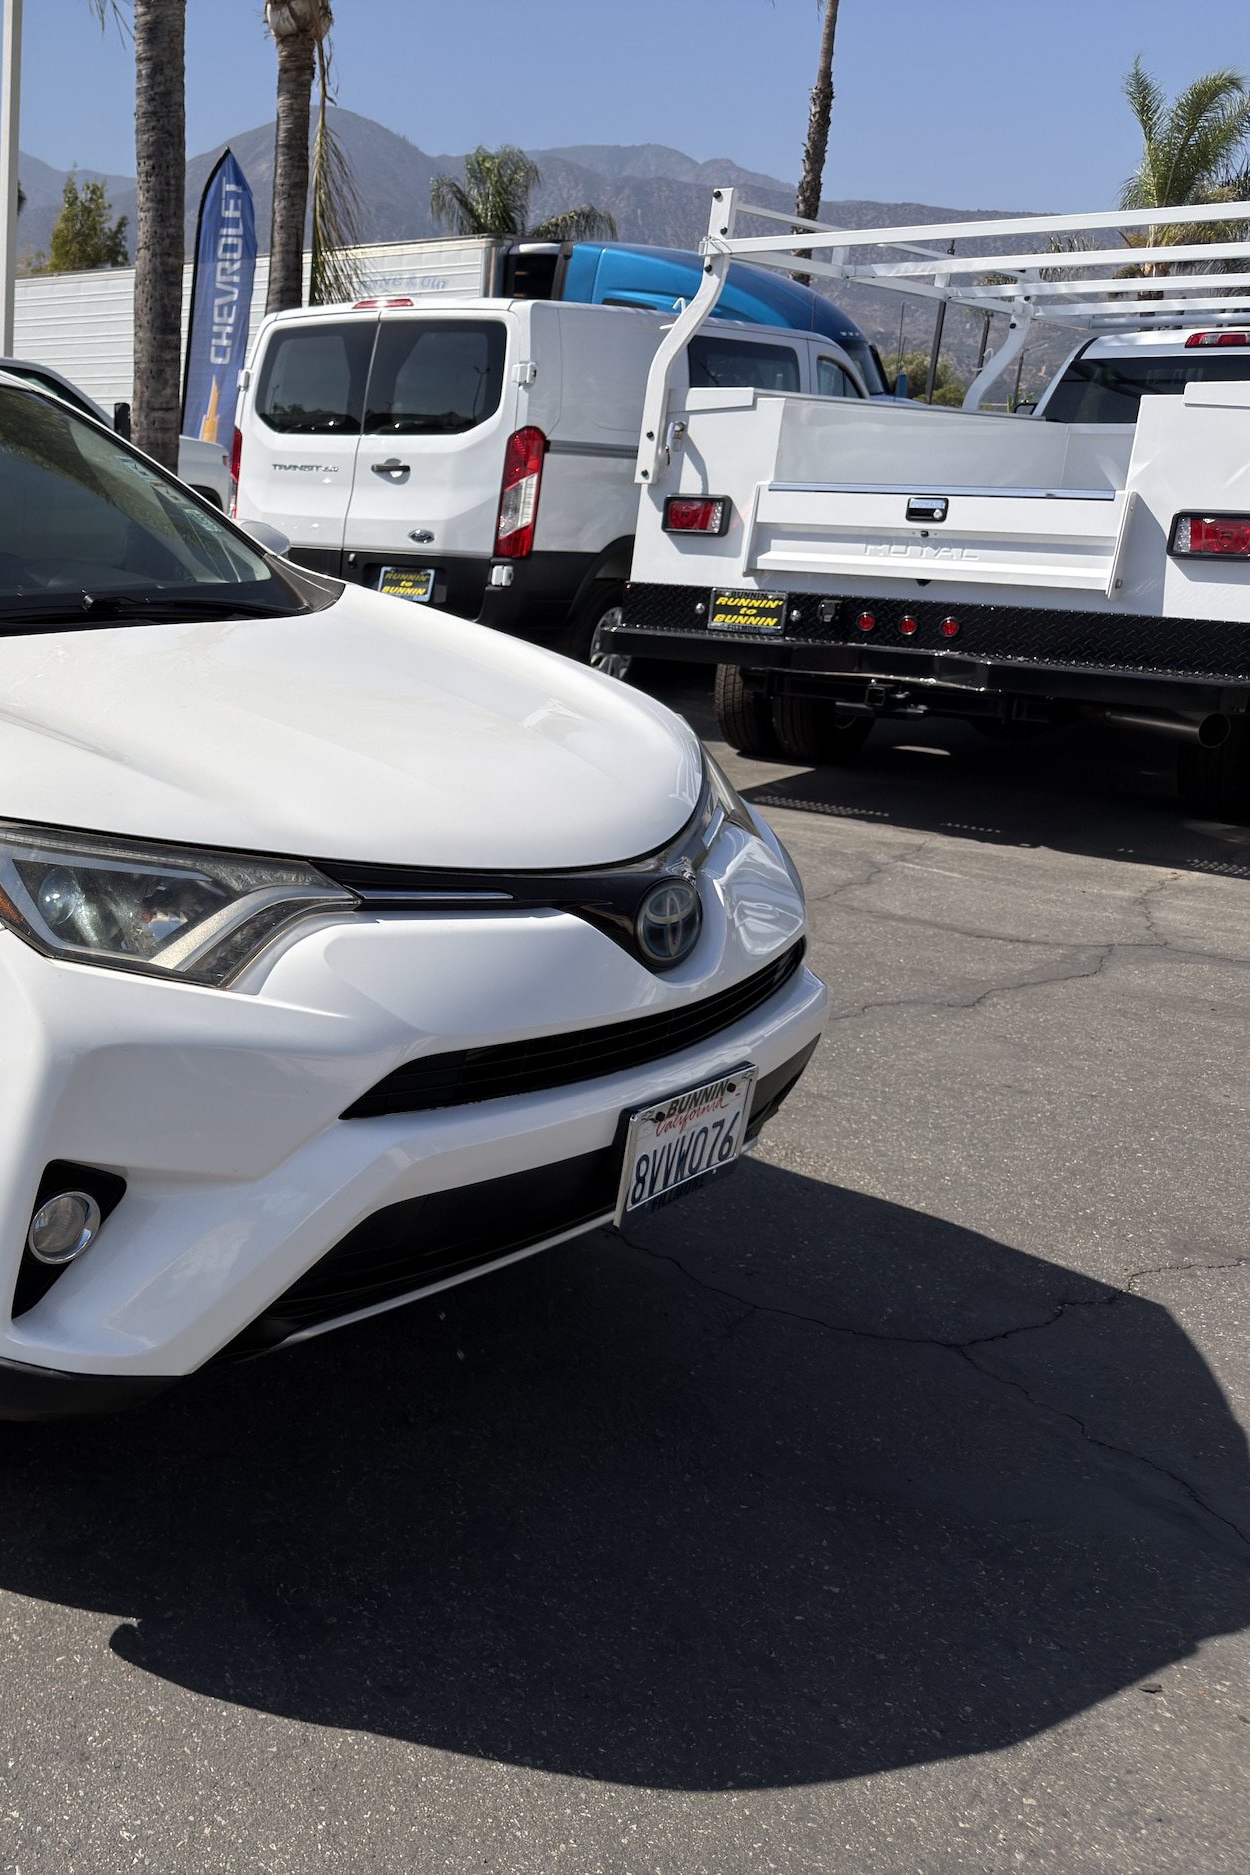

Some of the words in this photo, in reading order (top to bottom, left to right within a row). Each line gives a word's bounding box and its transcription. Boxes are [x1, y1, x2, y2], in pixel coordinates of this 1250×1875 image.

[209, 176, 244, 366] CHEVROLET
[271, 463, 323, 472] TRANSIT
[863, 539, 980, 561] ROYAL
[381, 585, 427, 596] BUNNIN
[399, 580, 414, 588] to
[715, 597, 784, 609] RUNNIN'
[739, 607, 758, 615] to
[712, 613, 778, 627] BUNNIN
[666, 1079, 729, 1119] BUNNIN
[655, 1096, 729, 1137] California
